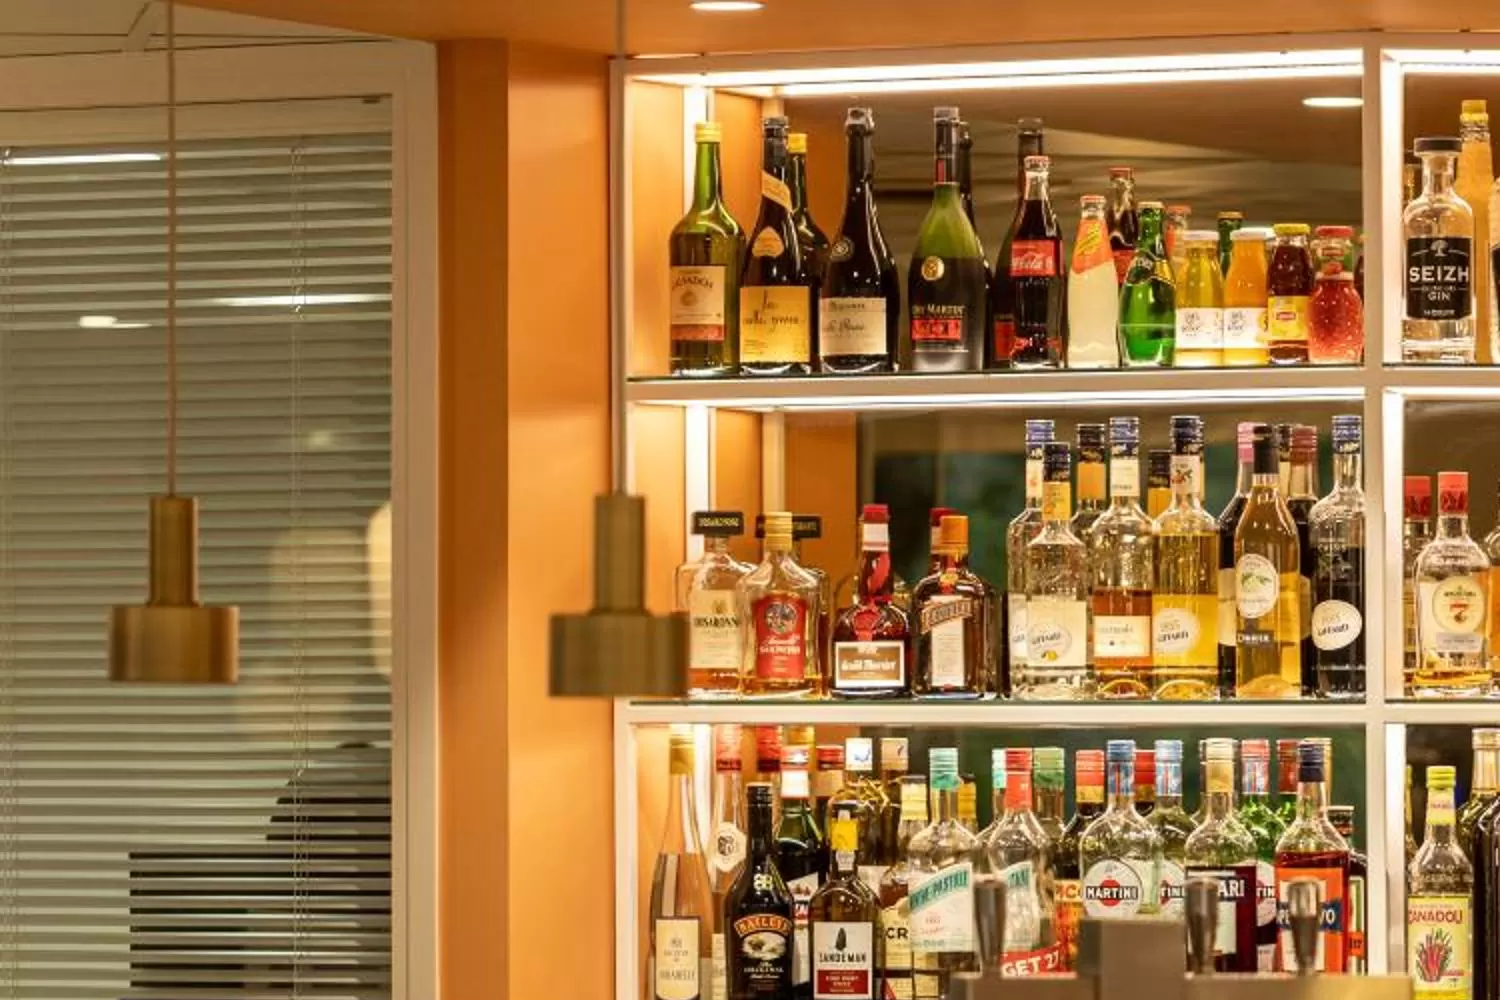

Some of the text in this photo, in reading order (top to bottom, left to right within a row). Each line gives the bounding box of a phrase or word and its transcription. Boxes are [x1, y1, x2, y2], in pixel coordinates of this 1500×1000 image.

[1409, 265, 1470, 283] SEIZH
[1427, 290, 1452, 301] GIN
[1087, 886, 1139, 899] MARTINI
[1160, 887, 1186, 898] TINI
[1217, 878, 1246, 897] ARI
[1002, 957, 1042, 977] GET
